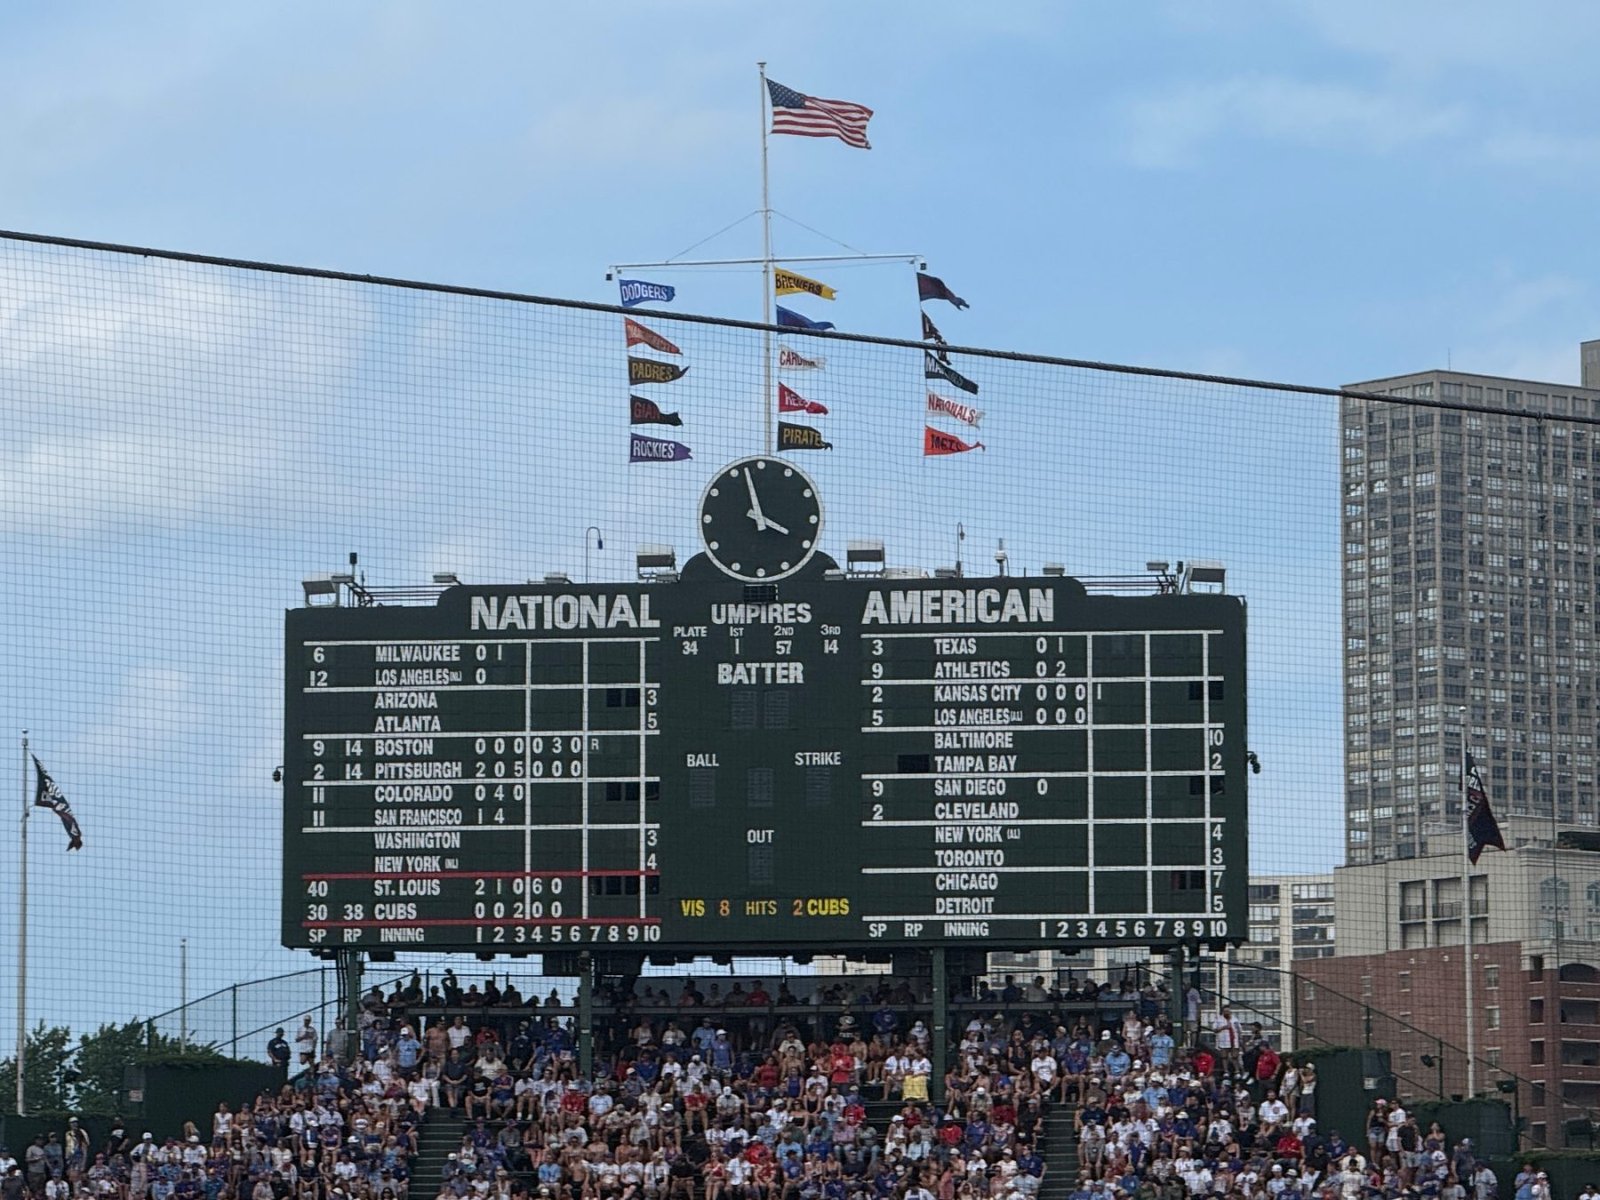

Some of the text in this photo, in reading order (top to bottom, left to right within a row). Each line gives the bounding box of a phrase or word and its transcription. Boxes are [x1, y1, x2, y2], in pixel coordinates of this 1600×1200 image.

[620, 283, 668, 302] DODGERS
[776, 273, 823, 296] BREWERS
[631, 362, 673, 381] PADRES
[634, 401, 661, 420] GIAN
[928, 394, 976, 424] NATIONALS
[632, 440, 675, 459] ROCKIES
[471, 594, 660, 630] NATIONAL
[711, 603, 812, 625] UMPIRES
[861, 588, 1054, 624] AMERICAN
[673, 626, 707, 637] PLATE
[774, 625, 794, 636] 2ND
[820, 624, 841, 635] 3RD
[313, 645, 486, 663] 6 MILWAUKEE 0
[682, 639, 839, 655] 34 57 14
[872, 637, 1047, 656] 3 TEXAS 0
[310, 670, 328, 687] 12
[375, 669, 397, 686] LOS
[399, 668, 450, 685] ANGELES
[474, 668, 486, 686] 0
[718, 662, 804, 685] BATTER
[872, 660, 1067, 679] 9 ATHLETICS 0 2
[374, 689, 657, 709] ARIZONA 3
[872, 684, 1086, 703] 2 KANSAS CITY 0 0 0
[374, 712, 657, 733] ATLANTA 5
[872, 709, 883, 726] 5
[934, 708, 957, 725] LOS
[959, 708, 1009, 725] ANGELES
[1036, 708, 1047, 724] 0
[1055, 708, 1067, 724] 0
[1075, 707, 1086, 725] 0
[313, 737, 599, 757] 9 14 BOSTON 0 0 0 0 3 0 R
[934, 731, 1013, 749] BALTIMORE
[687, 753, 719, 767] BALL
[795, 752, 841, 766] STRIKE
[934, 753, 1222, 772] TAMPA BAY 2
[314, 761, 582, 780] 2 14 PITTSBURGH 2 0 5 0 0 0
[375, 786, 453, 803] COLORADO
[475, 785, 486, 801] 0
[494, 784, 505, 801] 4
[513, 784, 524, 801] 0
[872, 778, 1048, 797] 9 SAN DIEGO 0
[374, 809, 397, 826] SAN
[399, 808, 462, 826] FRANCISCO
[494, 808, 505, 824] 4
[872, 802, 1019, 820] 2 CLEVELAND
[374, 830, 658, 849] WASHINGTON 3
[747, 829, 774, 843] OUT
[935, 826, 964, 843] NEW
[966, 826, 1003, 843] YORK
[1212, 824, 1223, 841] 4
[375, 856, 403, 872] NEW
[406, 856, 441, 872] YORK
[647, 853, 657, 870] 4
[935, 847, 1223, 867] TORONTO 3
[307, 878, 562, 897] 40 ST. LOUIS 2 0 6 0
[936, 871, 1223, 891] CHICAGO 7
[307, 901, 562, 921] 30 38 CUBS 0 0 2 0 0
[681, 898, 849, 917] VIS 8 HITS 2 CUBS
[936, 895, 1224, 914] DETROIT 5
[309, 925, 661, 943] SP RP INNING 2 3 4 5 6 7 8 9 10
[869, 920, 1227, 938] SP RP INNING 2 3 4 5 6 7 8 9 10
